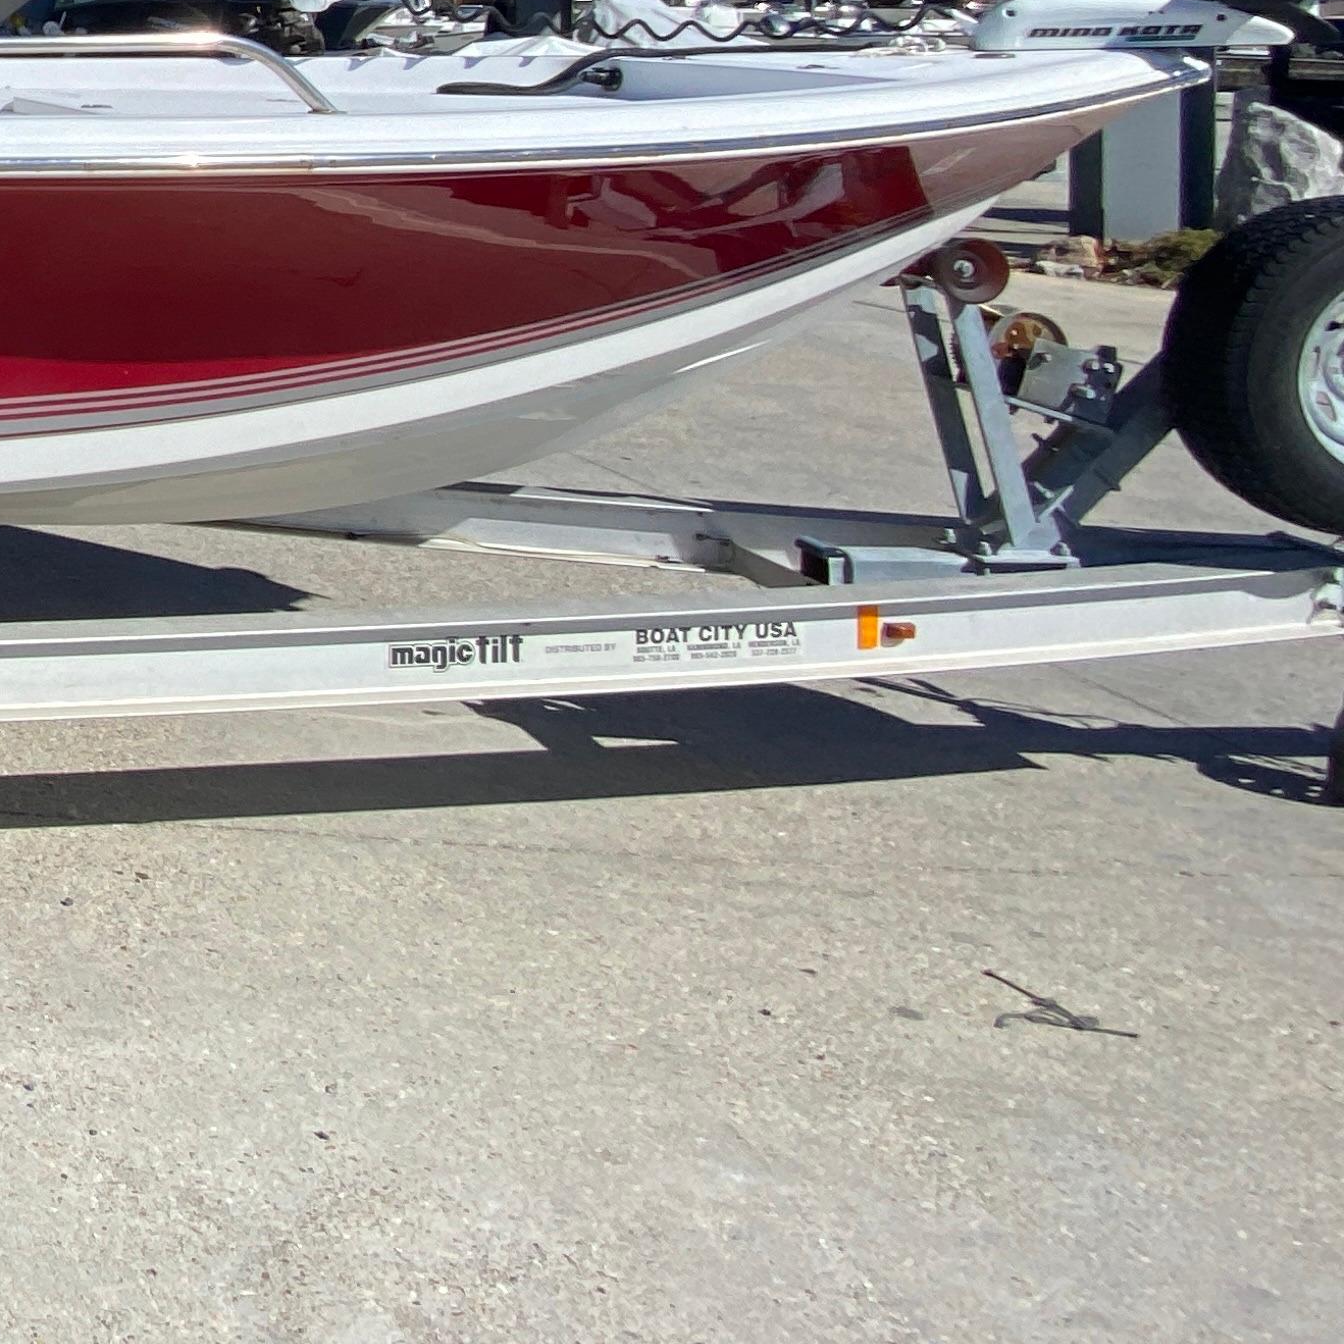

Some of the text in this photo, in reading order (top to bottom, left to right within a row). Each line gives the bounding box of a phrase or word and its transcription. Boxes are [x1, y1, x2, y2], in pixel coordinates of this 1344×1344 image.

[1117, 23, 1204, 37] KOTA
[635, 622, 797, 644] BOAT CITY USA
